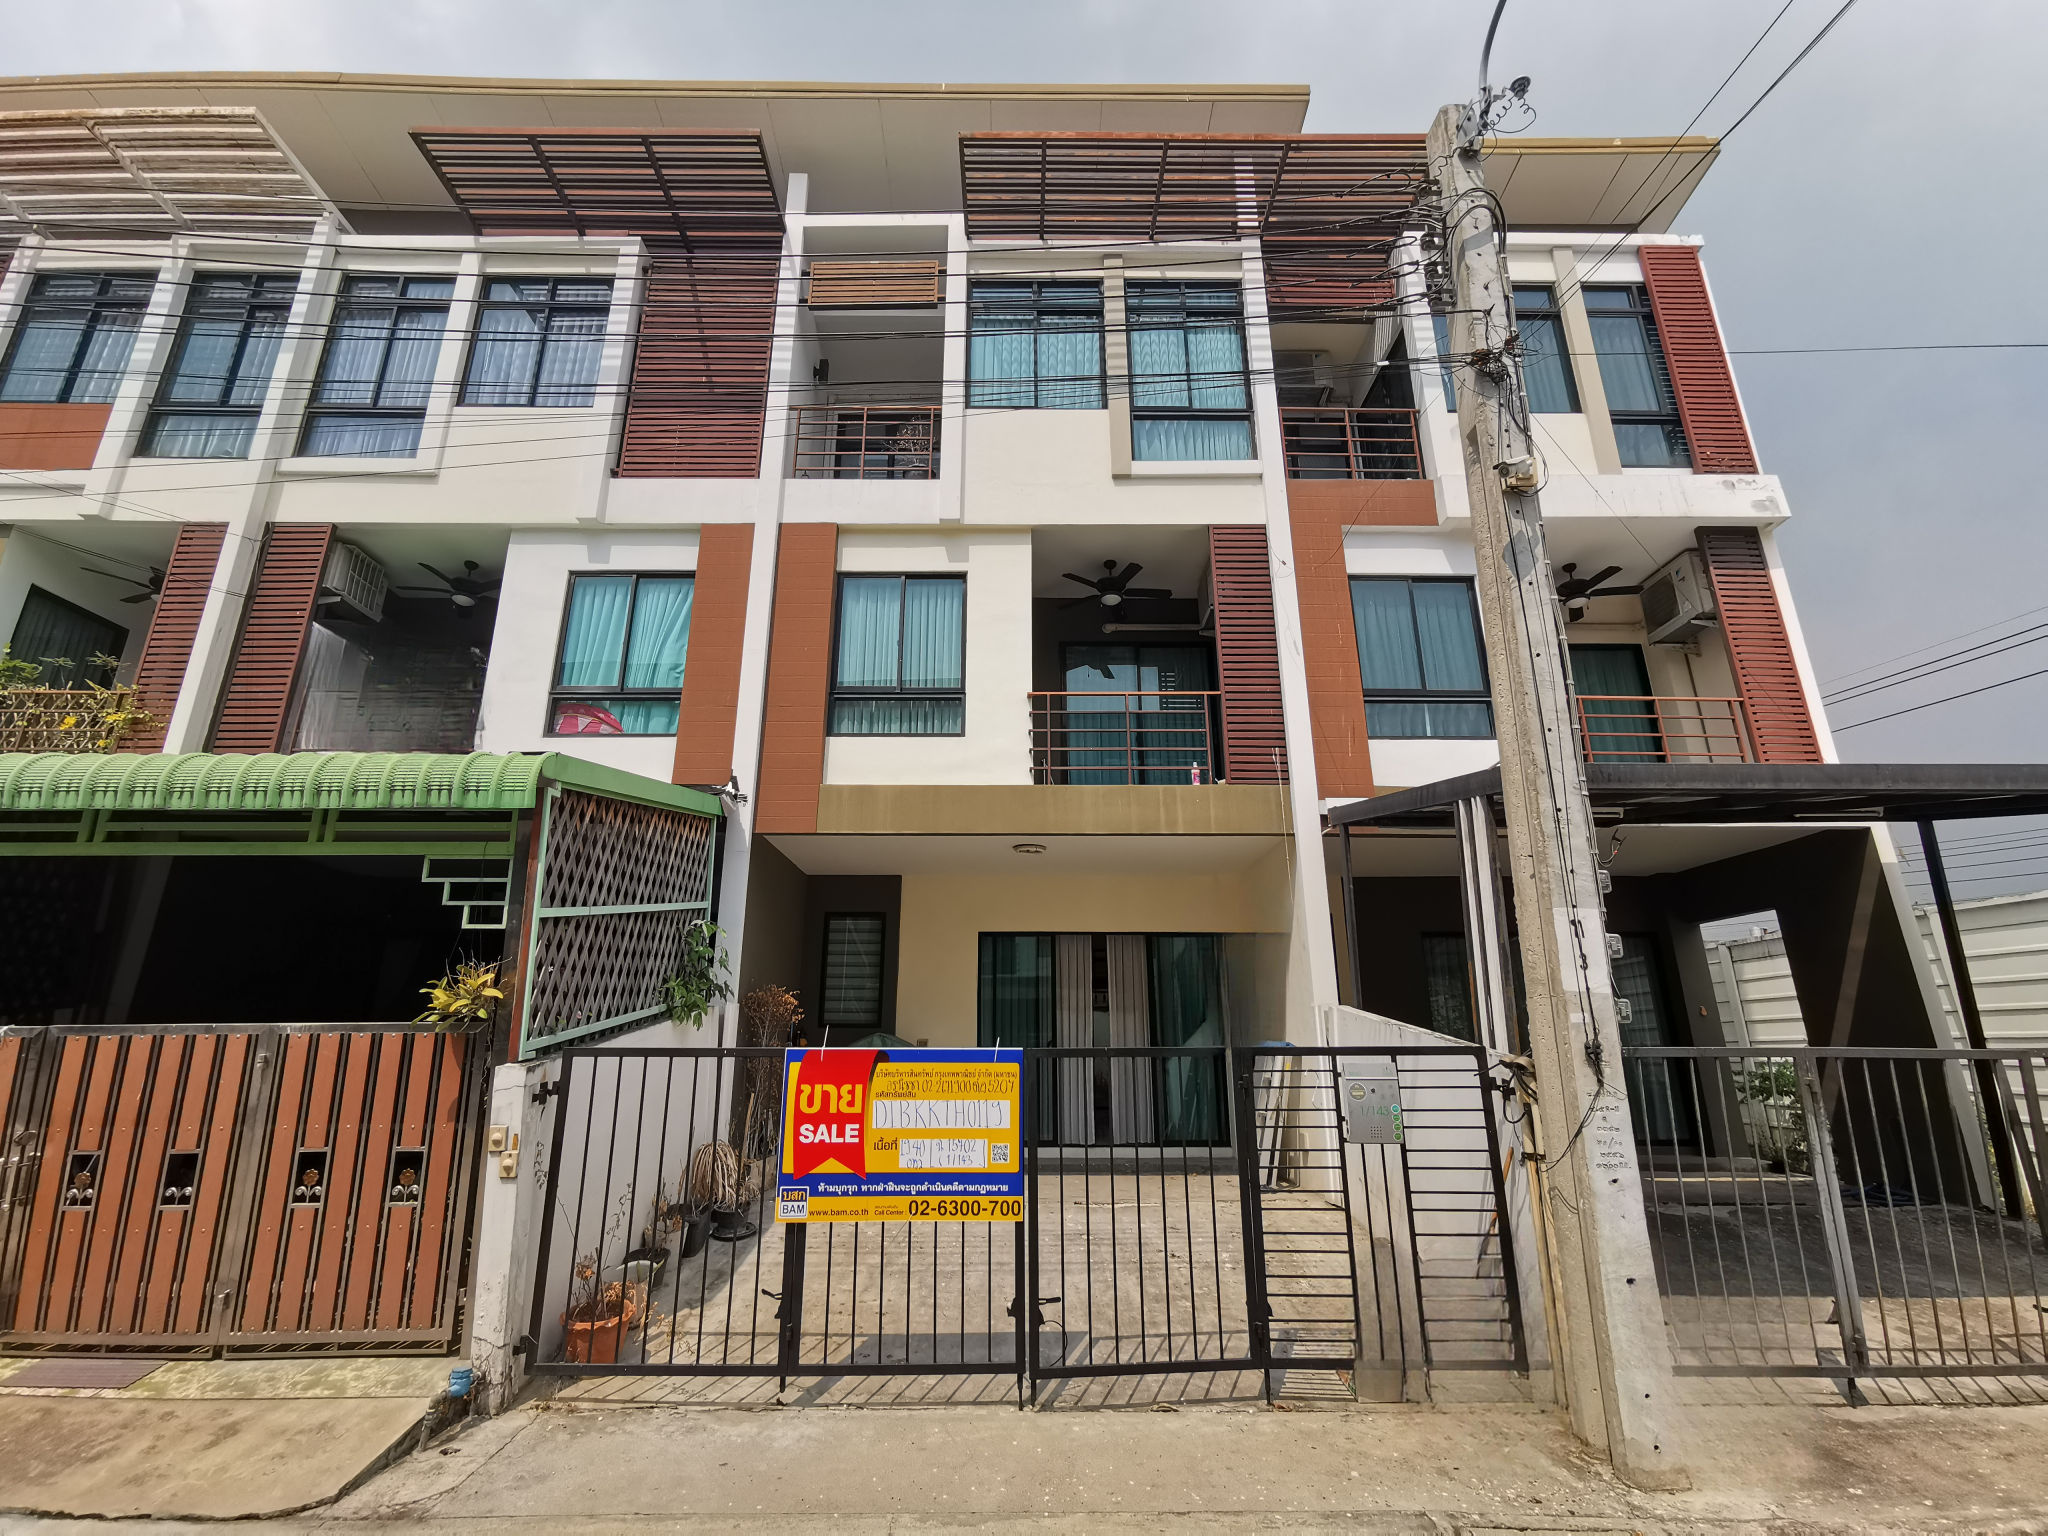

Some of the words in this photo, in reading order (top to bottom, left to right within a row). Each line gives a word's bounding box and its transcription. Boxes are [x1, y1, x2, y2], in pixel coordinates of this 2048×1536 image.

[800, 1084, 863, 1114] ขาย
[1361, 1104, 1390, 1117] 1/143
[799, 1123, 860, 1144] SALE
[873, 1136, 898, 1151] เนื้อที่
[783, 1190, 806, 1201] บสก
[818, 1182, 858, 1196] ห้ามบุกรุก
[782, 1204, 805, 1214] BAM
[908, 1200, 1022, 1216] 02-6300-700
